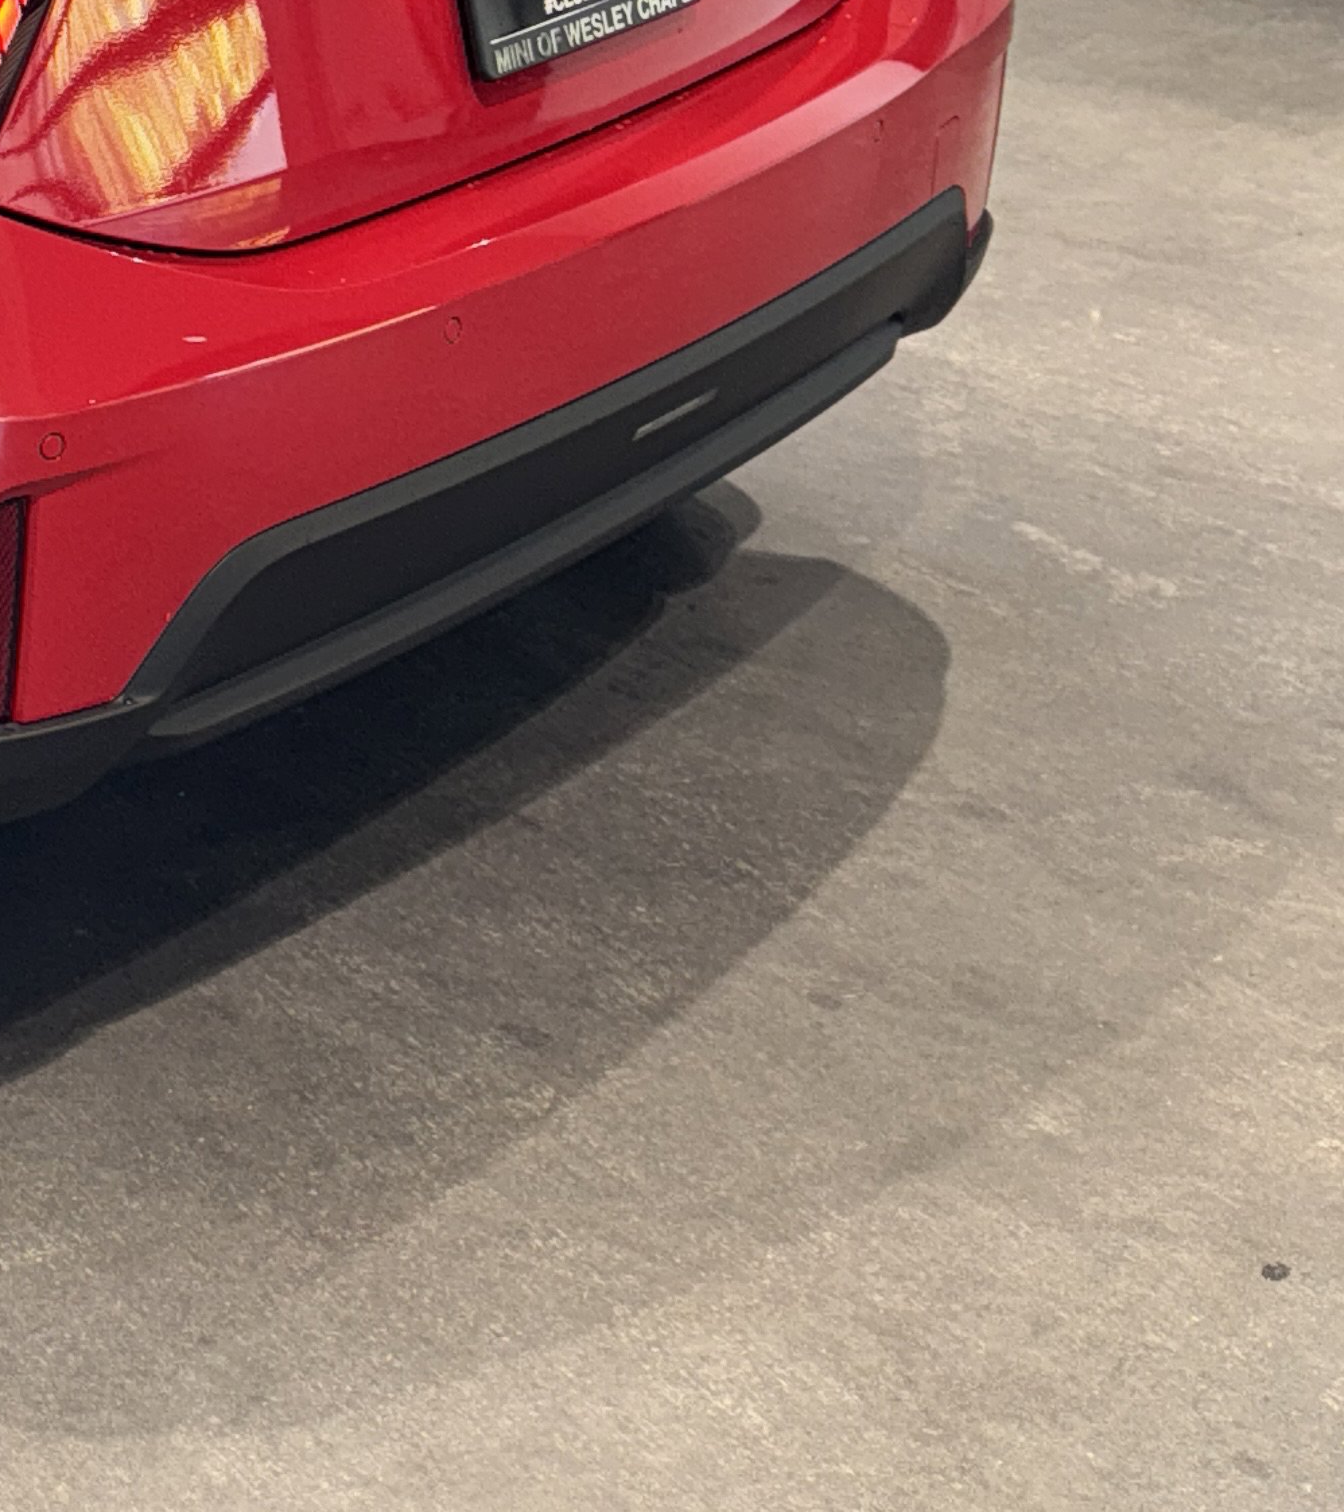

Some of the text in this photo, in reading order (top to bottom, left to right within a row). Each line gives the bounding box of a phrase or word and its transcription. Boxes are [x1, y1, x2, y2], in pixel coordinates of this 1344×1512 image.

[494, 41, 534, 74] MINI
[537, 32, 562, 58] OF
[563, 1, 634, 48] WESLEY
